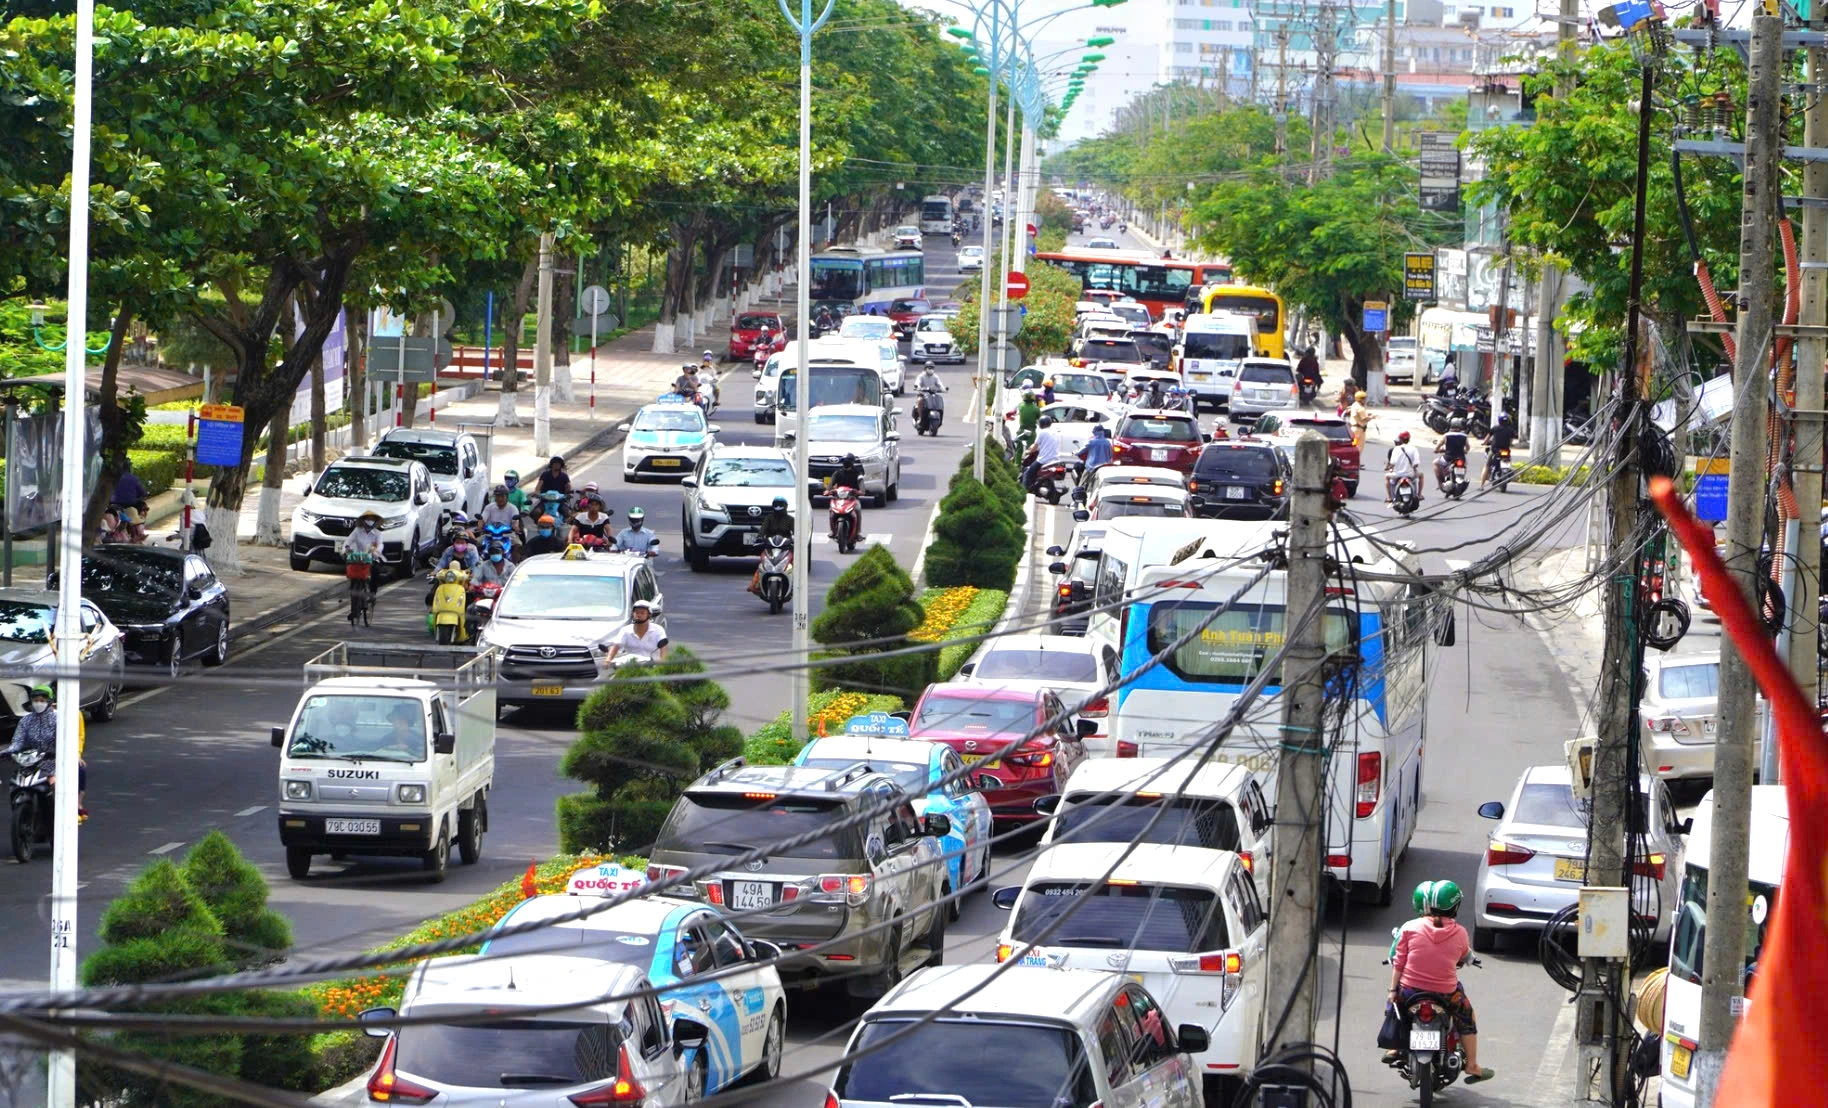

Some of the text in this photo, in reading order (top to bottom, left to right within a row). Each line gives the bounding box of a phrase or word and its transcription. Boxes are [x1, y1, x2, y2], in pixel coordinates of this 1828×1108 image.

[870, 714, 887, 723] TAXI
[327, 769, 380, 780] SUZUKI
[599, 867, 619, 877] TAXI
[574, 877, 618, 890] QUỐC
[742, 883, 763, 896] 49A
[735, 895, 771, 909] 144.59
[1025, 956, 1046, 966] TRANG
